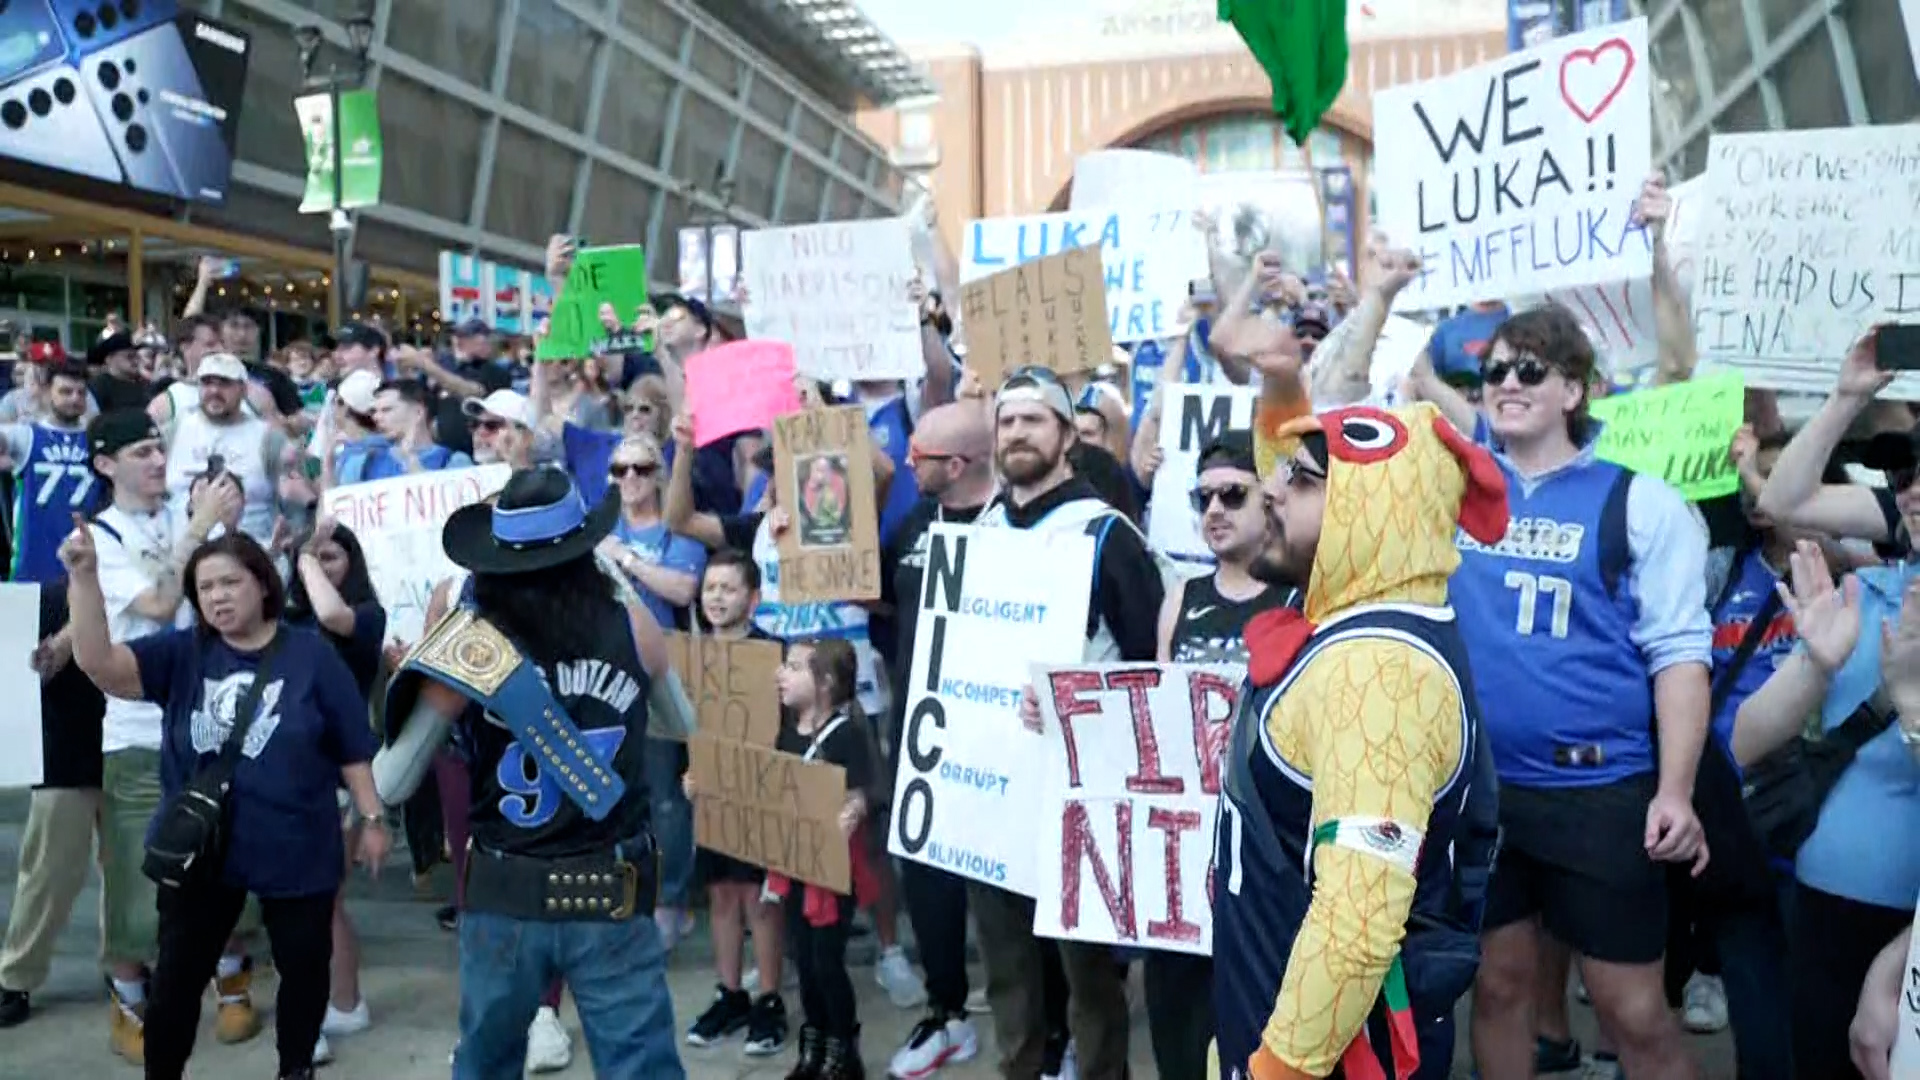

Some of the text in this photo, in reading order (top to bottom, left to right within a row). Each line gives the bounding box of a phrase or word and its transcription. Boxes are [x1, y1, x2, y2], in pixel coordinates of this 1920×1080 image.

[1412, 58, 1544, 164] WE
[973, 213, 1120, 264] LUKA
[1703, 255, 1738, 298] HE
[1753, 255, 1818, 306] HAD
[1829, 265, 1875, 315] US
[34, 461, 94, 506] 77
[1504, 570, 1573, 640] 77
[555, 658, 641, 714] OUTLAW
[1048, 668, 1238, 795] FIR
[1060, 798, 1216, 942] NI
